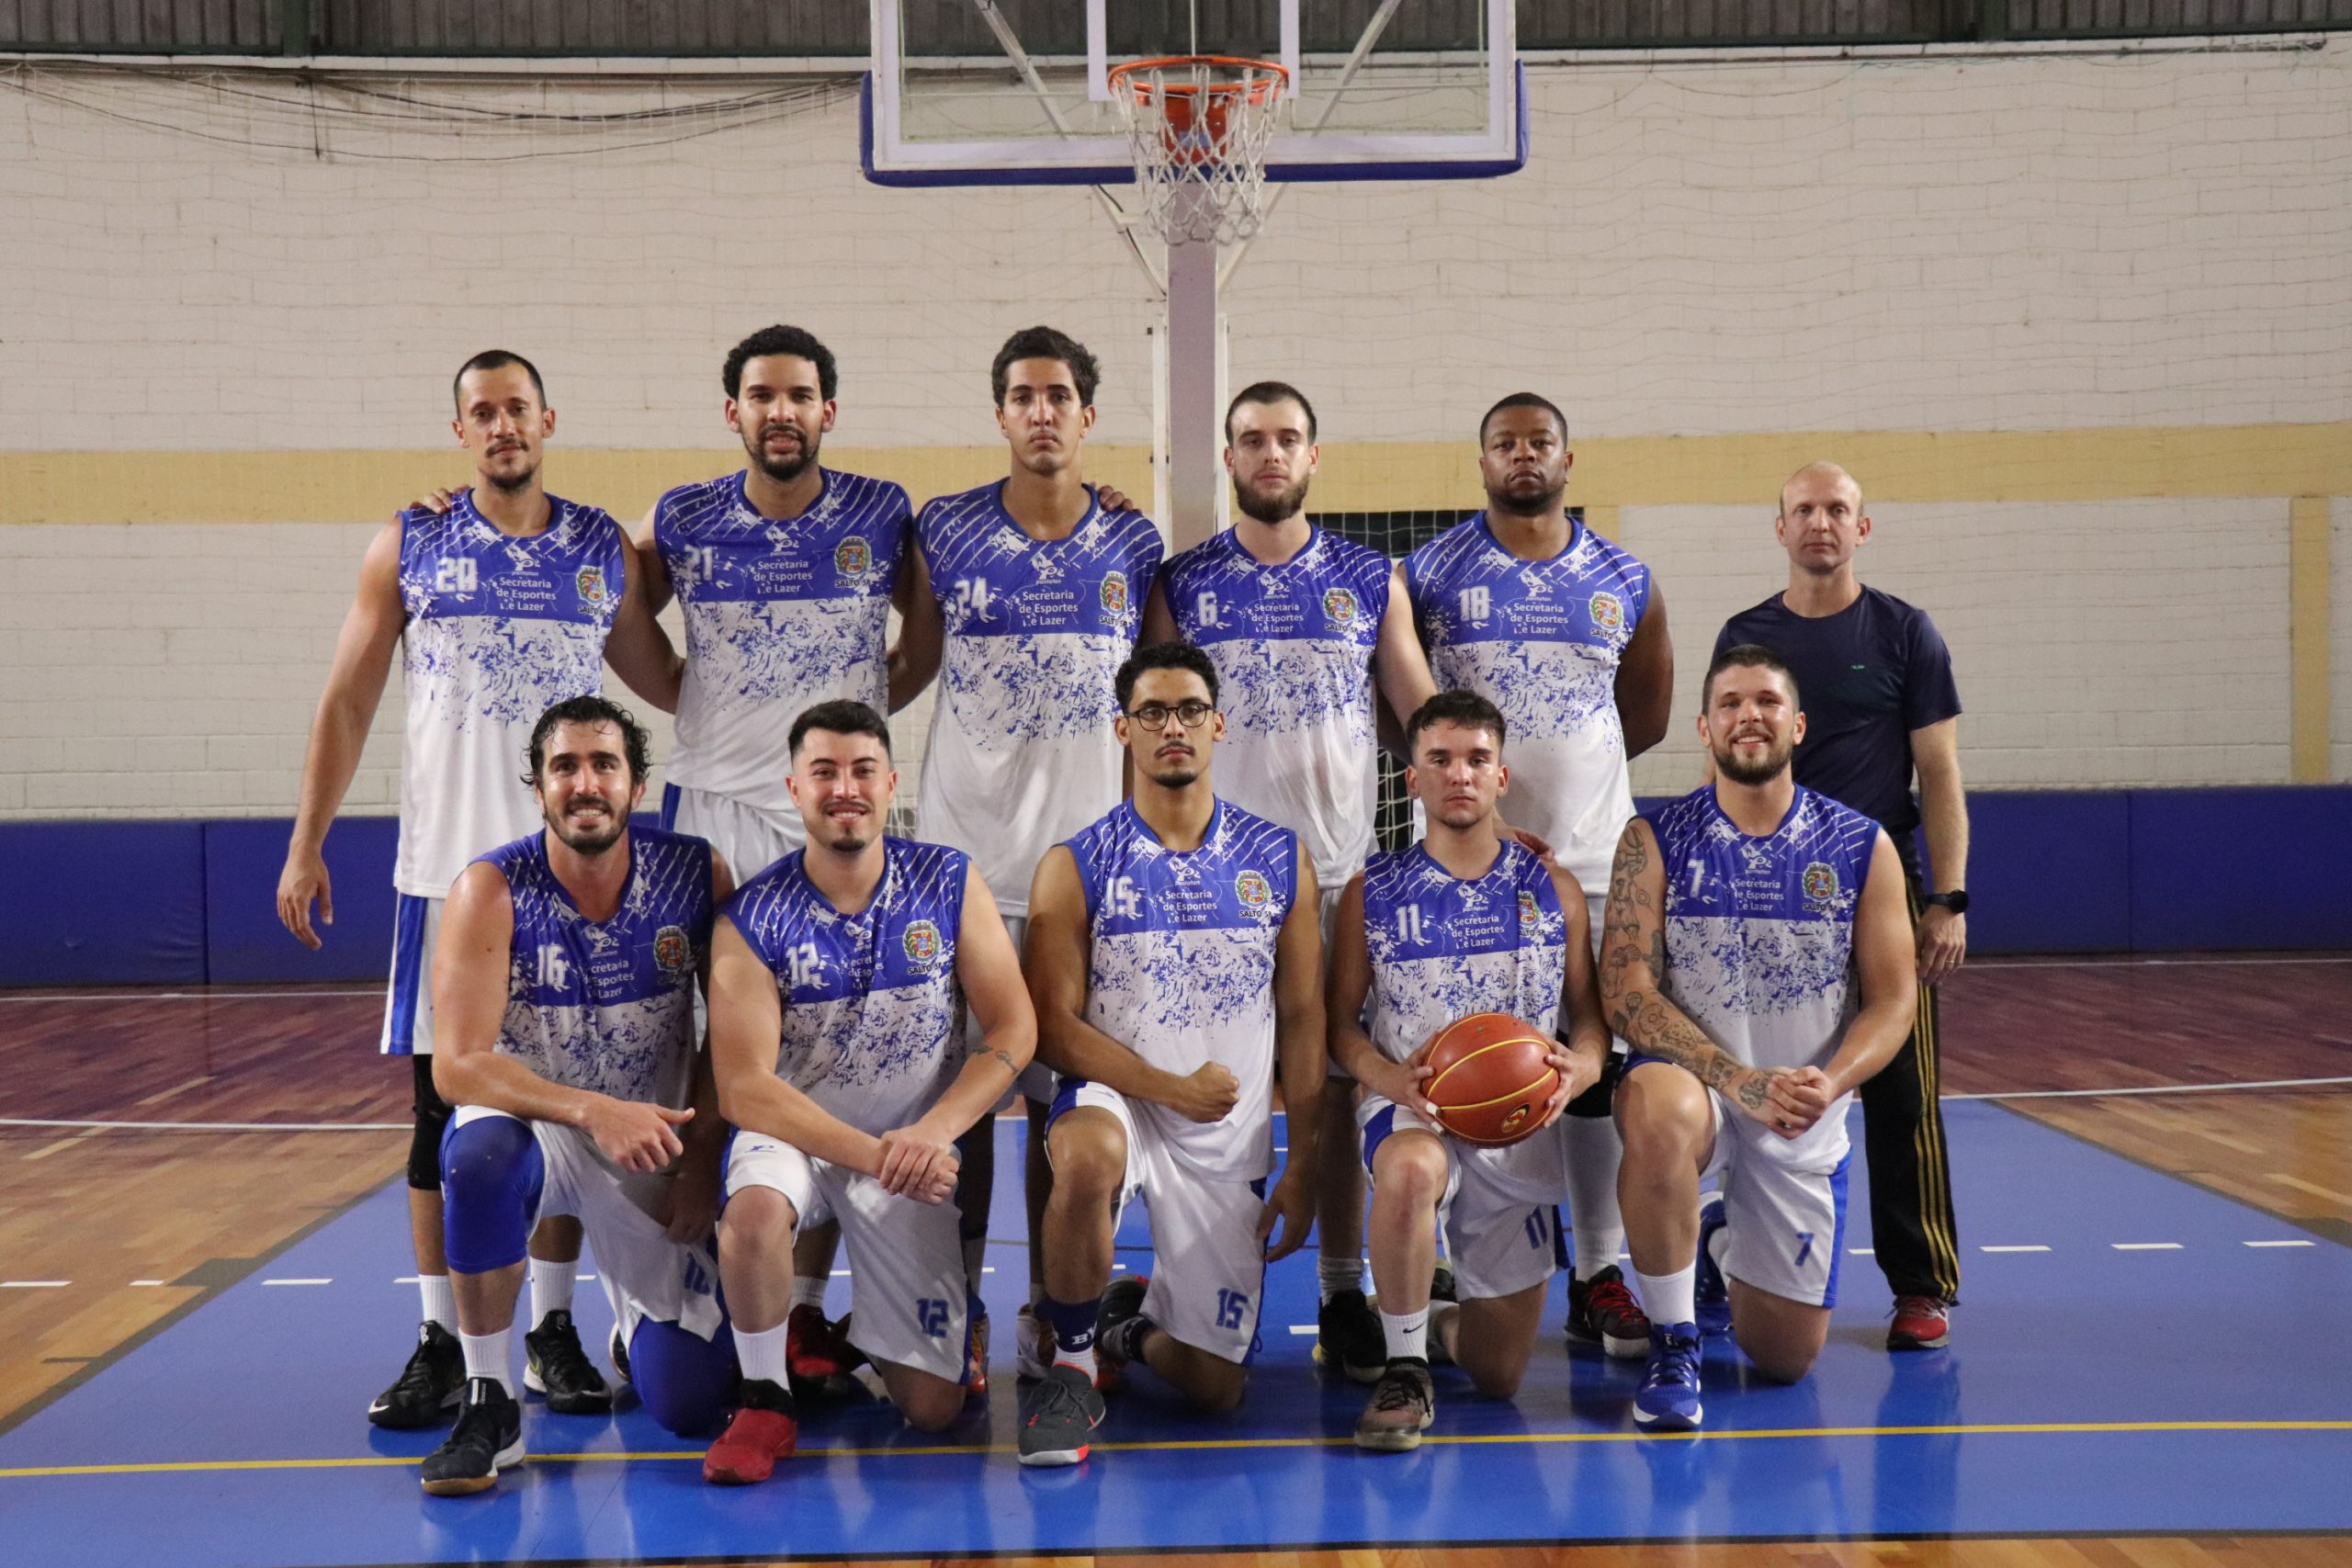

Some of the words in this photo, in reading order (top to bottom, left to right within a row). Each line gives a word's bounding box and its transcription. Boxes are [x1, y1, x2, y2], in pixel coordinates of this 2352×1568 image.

[684, 544, 713, 581] 21
[757, 560, 808, 570] Secretaria
[436, 557, 478, 592] 20
[753, 572, 766, 581] de
[769, 572, 813, 583] Esportes
[500, 577, 552, 589] Secretaria
[775, 583, 800, 594] Lazer
[835, 580, 860, 588] SALTO
[496, 589, 509, 598] de
[512, 589, 557, 601] Esportes
[955, 578, 989, 616] 24
[1023, 591, 1074, 601] Secretaria
[517, 603, 545, 612] Lazer
[1198, 591, 1217, 626] 6
[1254, 604, 1300, 613] Secretaria
[1458, 585, 1490, 621] 18
[1513, 604, 1564, 613] Secretaria
[578, 605, 597, 615] SALTO
[1019, 604, 1032, 614] de
[1035, 603, 1078, 615] Esportes
[1040, 615, 1066, 626] Lazer
[1100, 615, 1118, 626] SALTO
[1251, 614, 1262, 622] de
[1265, 613, 1305, 623] Esportes
[1510, 614, 1523, 623] de
[1525, 615, 1568, 625] Esportes
[1271, 625, 1294, 633] Lazer
[1325, 624, 1348, 632] SALTO
[1531, 626, 1556, 635] Lazer
[1591, 628, 1613, 640] SALTO
[1687, 859, 1705, 897] 7
[1735, 879, 1781, 889] Secretaria
[1106, 875, 1136, 919] 15
[1165, 890, 1213, 899] Secretaria
[1746, 890, 1784, 900] Esportes
[1162, 902, 1174, 911] de
[1176, 901, 1217, 911] Esportes
[1750, 901, 1773, 911] Lazer
[1182, 914, 1207, 922] Lazer
[1396, 903, 1420, 942] 11
[1453, 914, 1499, 927] Secretaria
[1452, 929, 1464, 938] de
[1465, 926, 1505, 937] Esportes
[1470, 938, 1495, 948] Lazer
[537, 943, 566, 987] 16
[786, 942, 821, 989] 12
[908, 964, 932, 975] SALTO
[1794, 1232, 1815, 1267] 7
[1216, 1287, 1249, 1330] 15
[916, 1297, 949, 1338] 12
